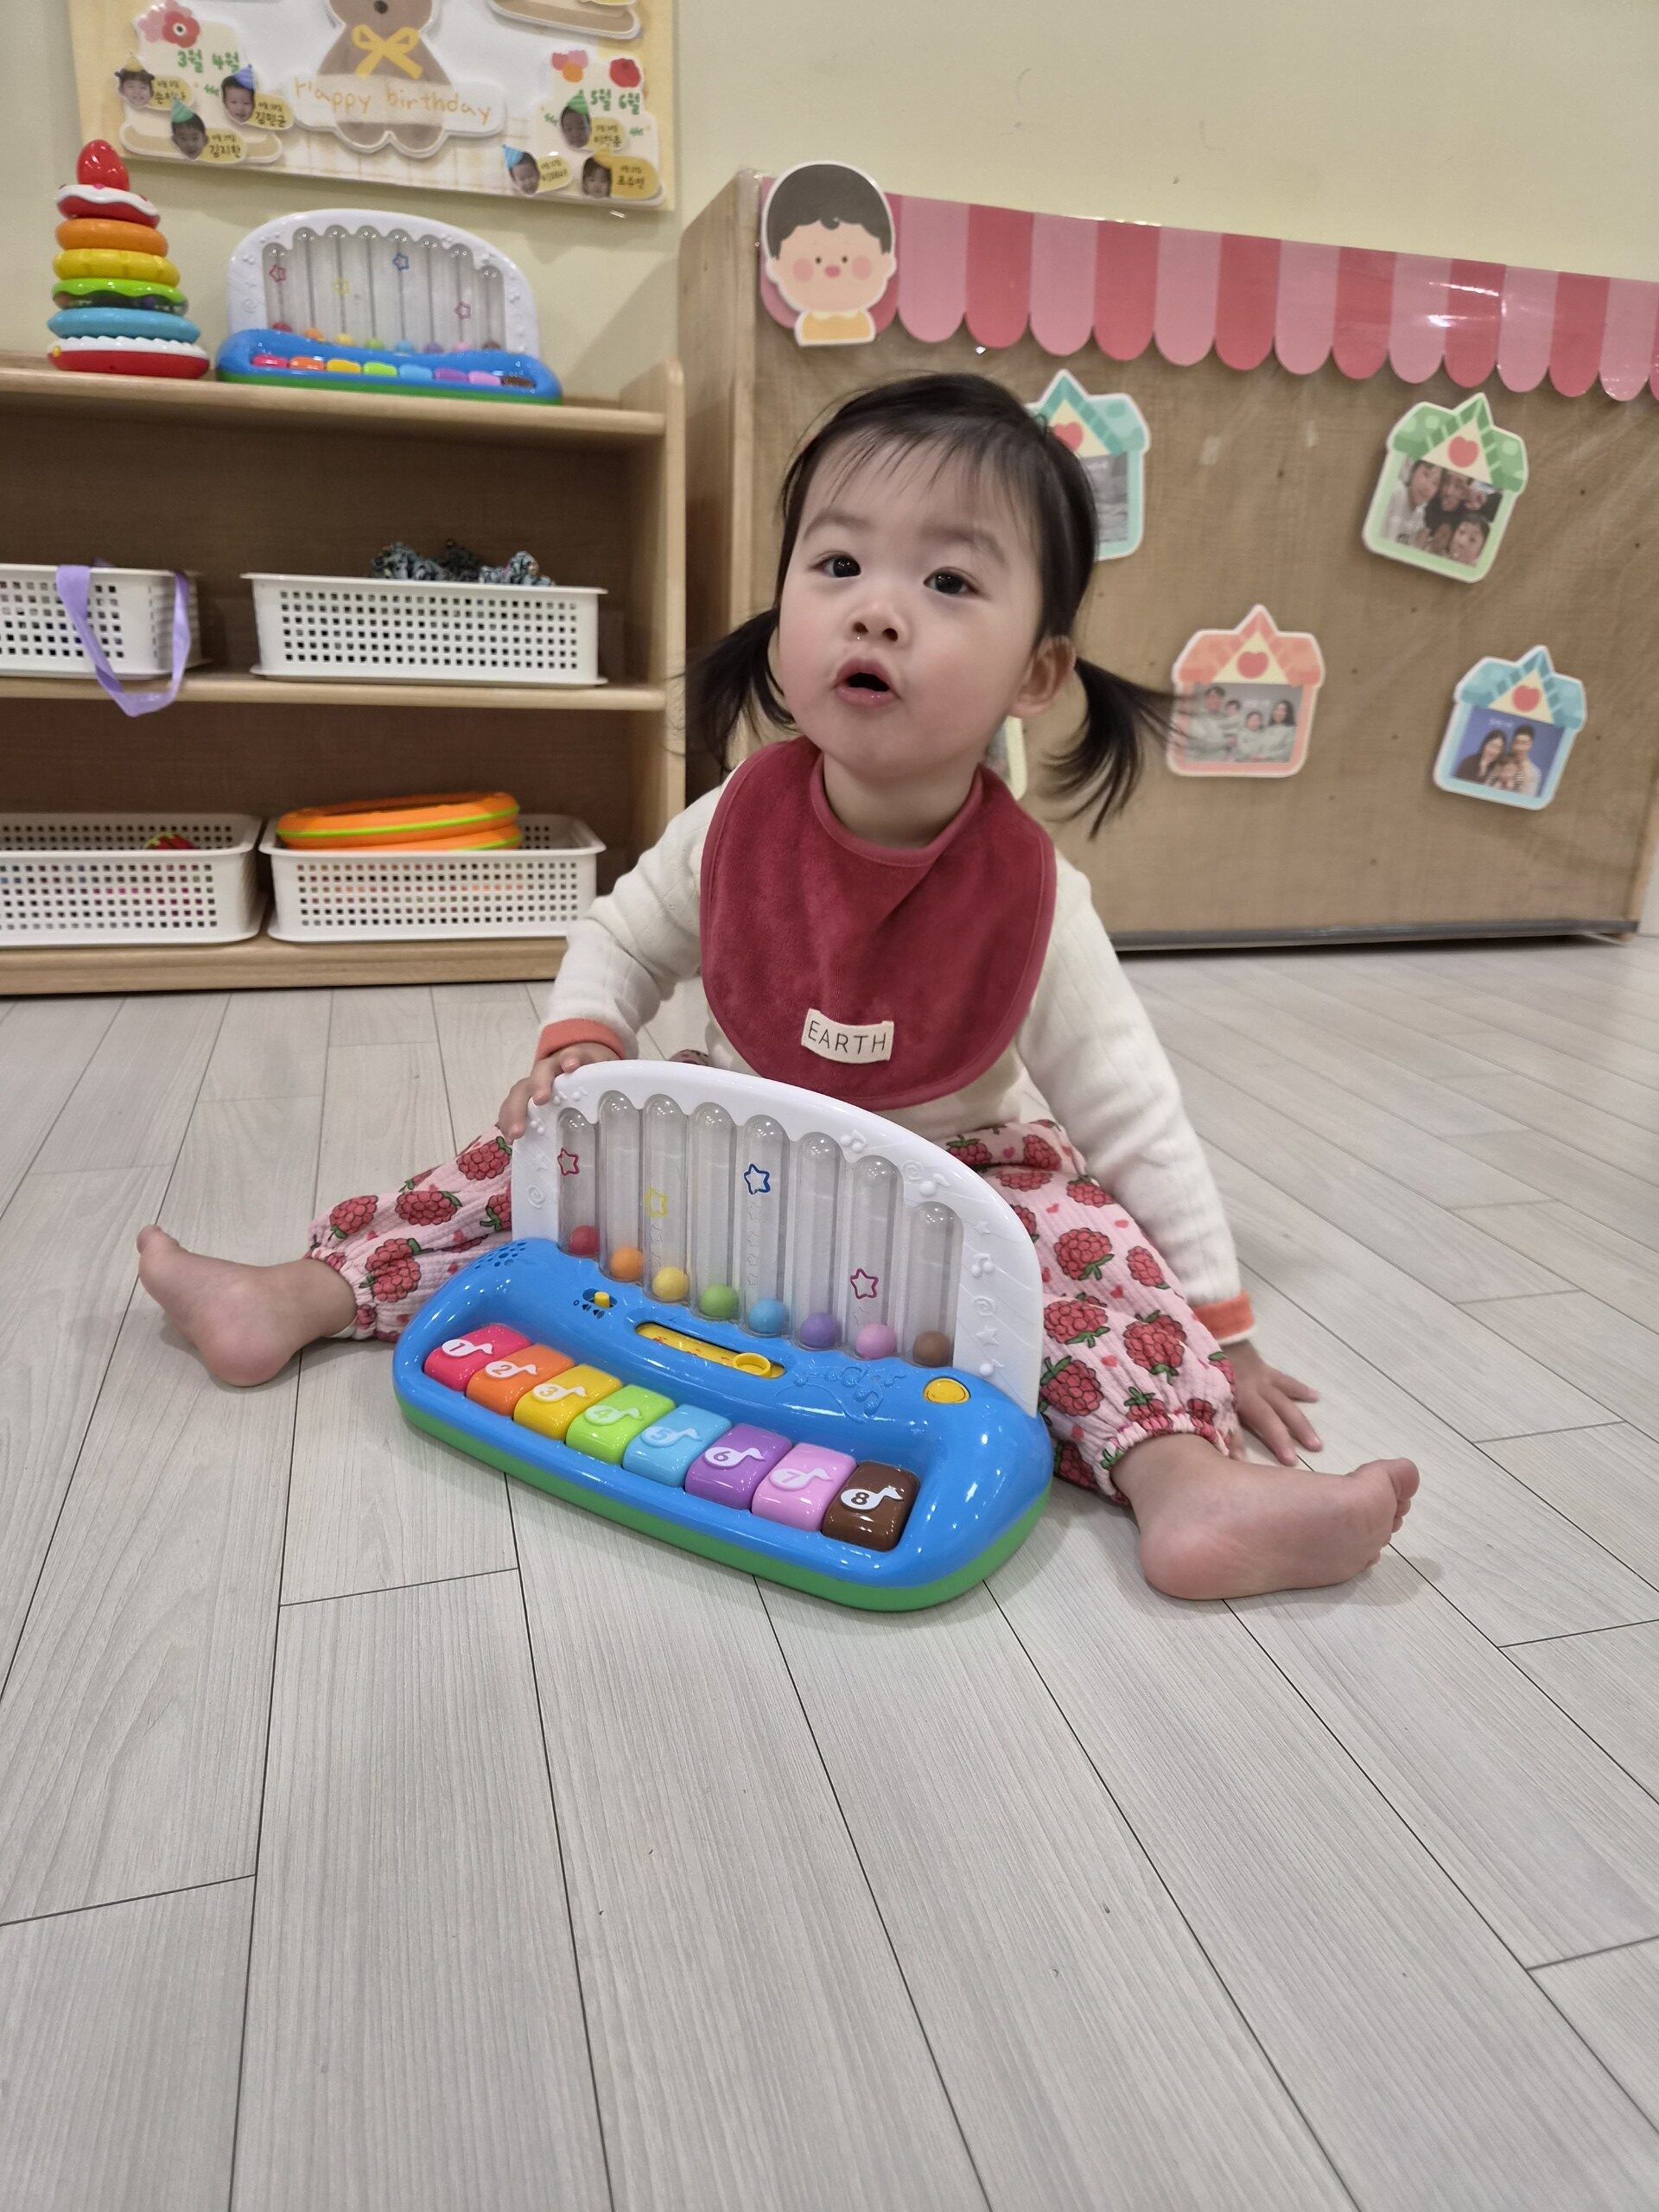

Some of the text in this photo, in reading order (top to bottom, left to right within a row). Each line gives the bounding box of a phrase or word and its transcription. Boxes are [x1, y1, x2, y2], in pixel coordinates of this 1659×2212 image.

[178, 49, 239, 73] 3월 4월
[294, 76, 492, 124] Happy birthday
[591, 89, 640, 115] 5월 6월
[808, 1020, 887, 1054] EARTH
[449, 1342, 466, 1352] 1
[492, 1363, 512, 1375] 2
[539, 1386, 558, 1397] 3
[594, 1408, 614, 1419] 4
[652, 1427, 671, 1440] 5
[713, 1451, 730, 1462] 6
[781, 1471, 798, 1484] 7
[850, 1491, 869, 1506] 8
